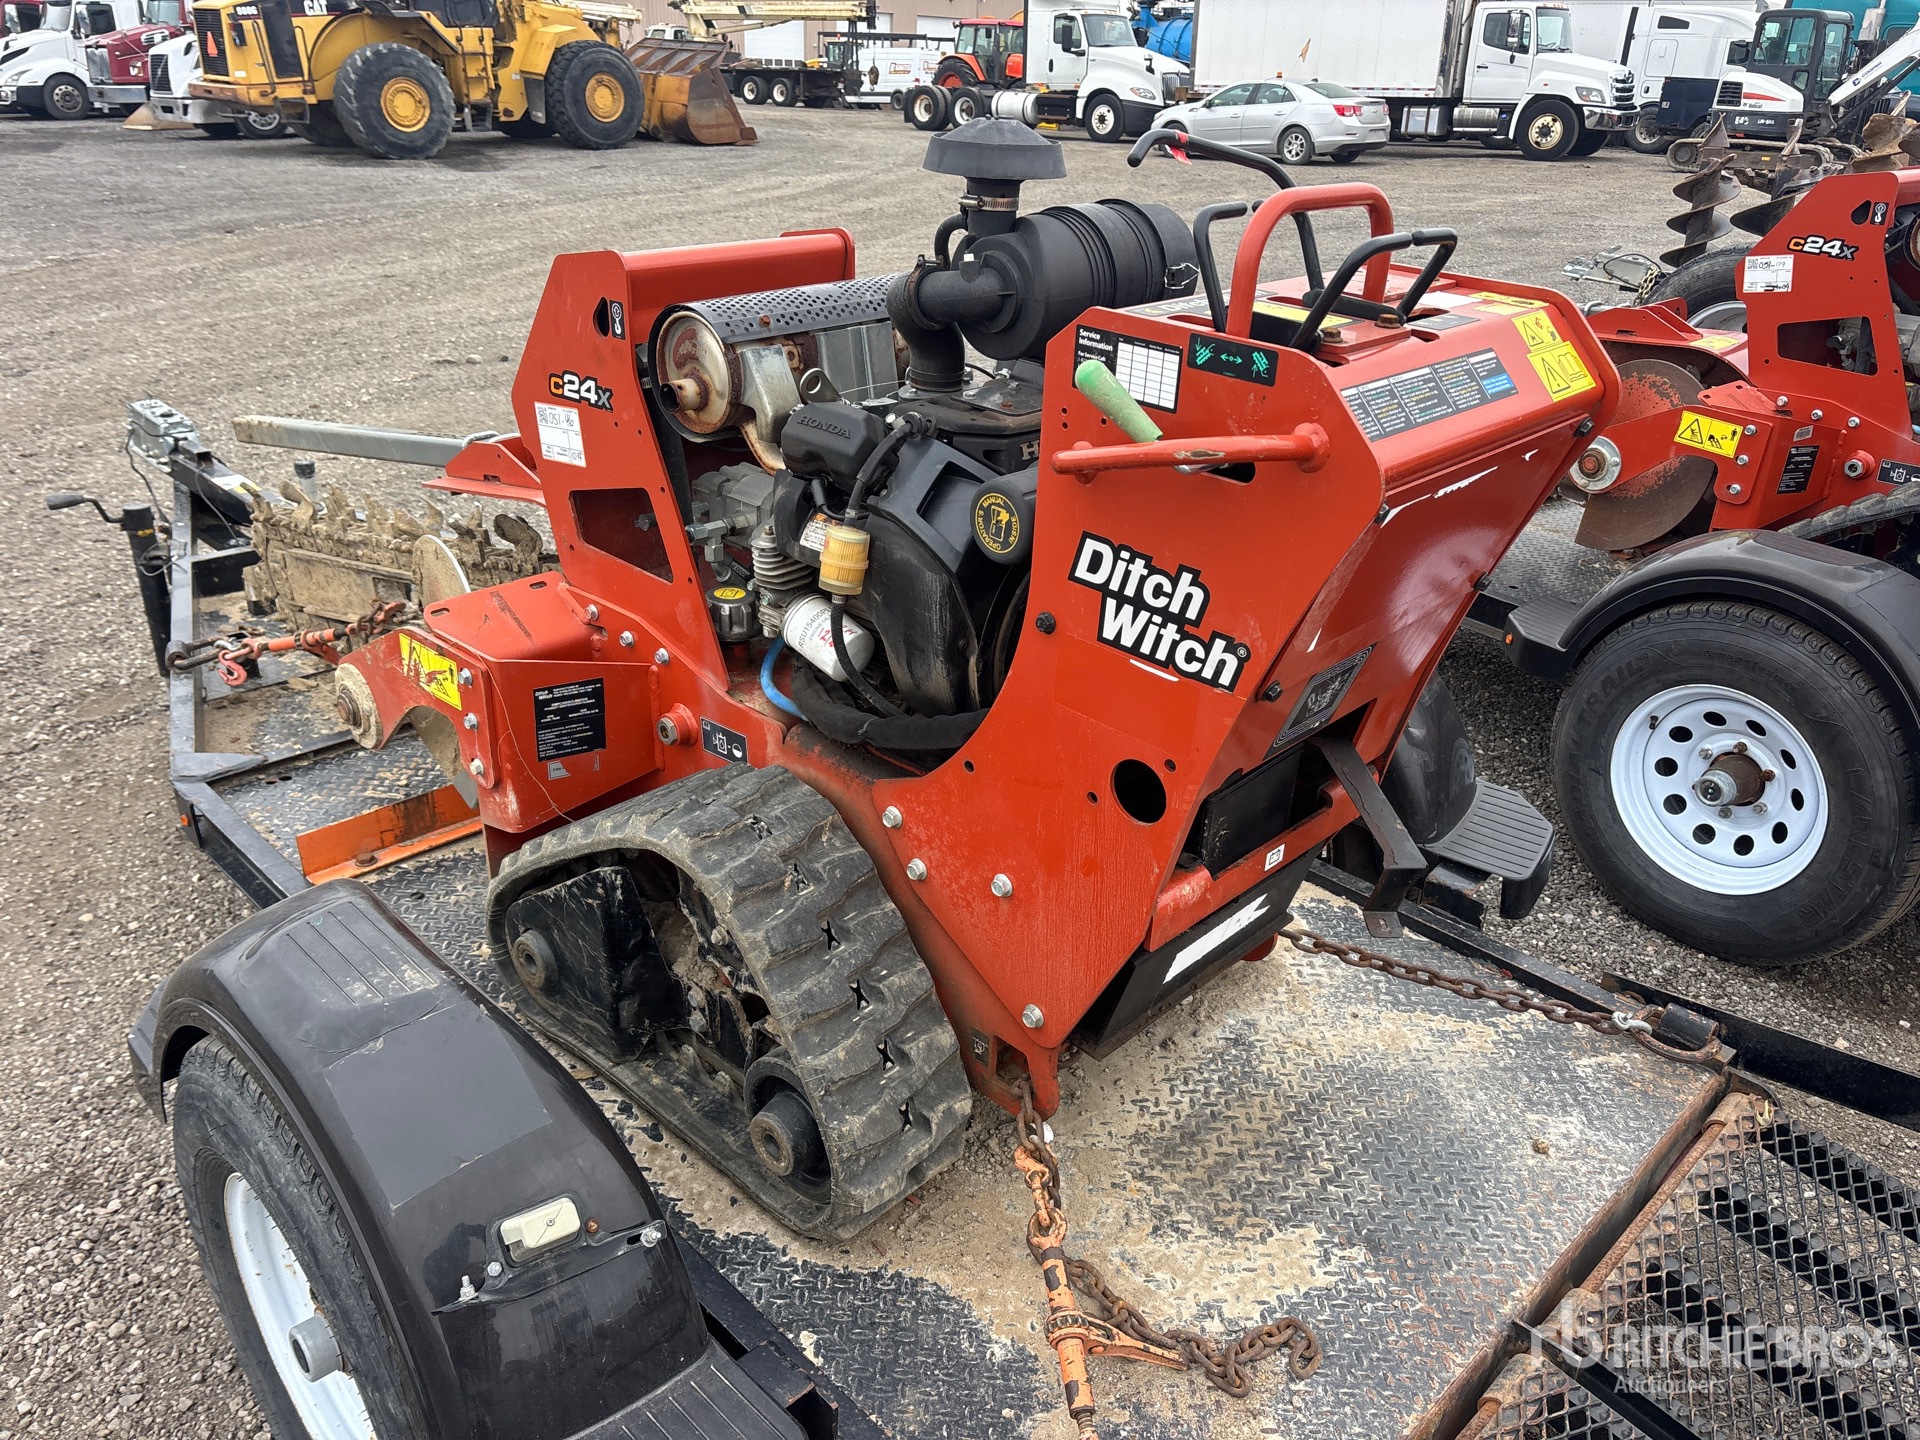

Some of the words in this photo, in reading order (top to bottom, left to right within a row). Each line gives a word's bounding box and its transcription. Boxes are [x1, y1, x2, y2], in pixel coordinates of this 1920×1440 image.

[304, 0, 328, 15] CAT
[1078, 337, 1113, 351] Information
[1079, 328, 1101, 340] Service
[797, 416, 851, 439] HONDA
[982, 496, 1005, 508] MANUAL
[1008, 515, 1017, 545] INSIDE
[1074, 538, 1204, 620] Ditch
[1102, 597, 1239, 687] Witch
